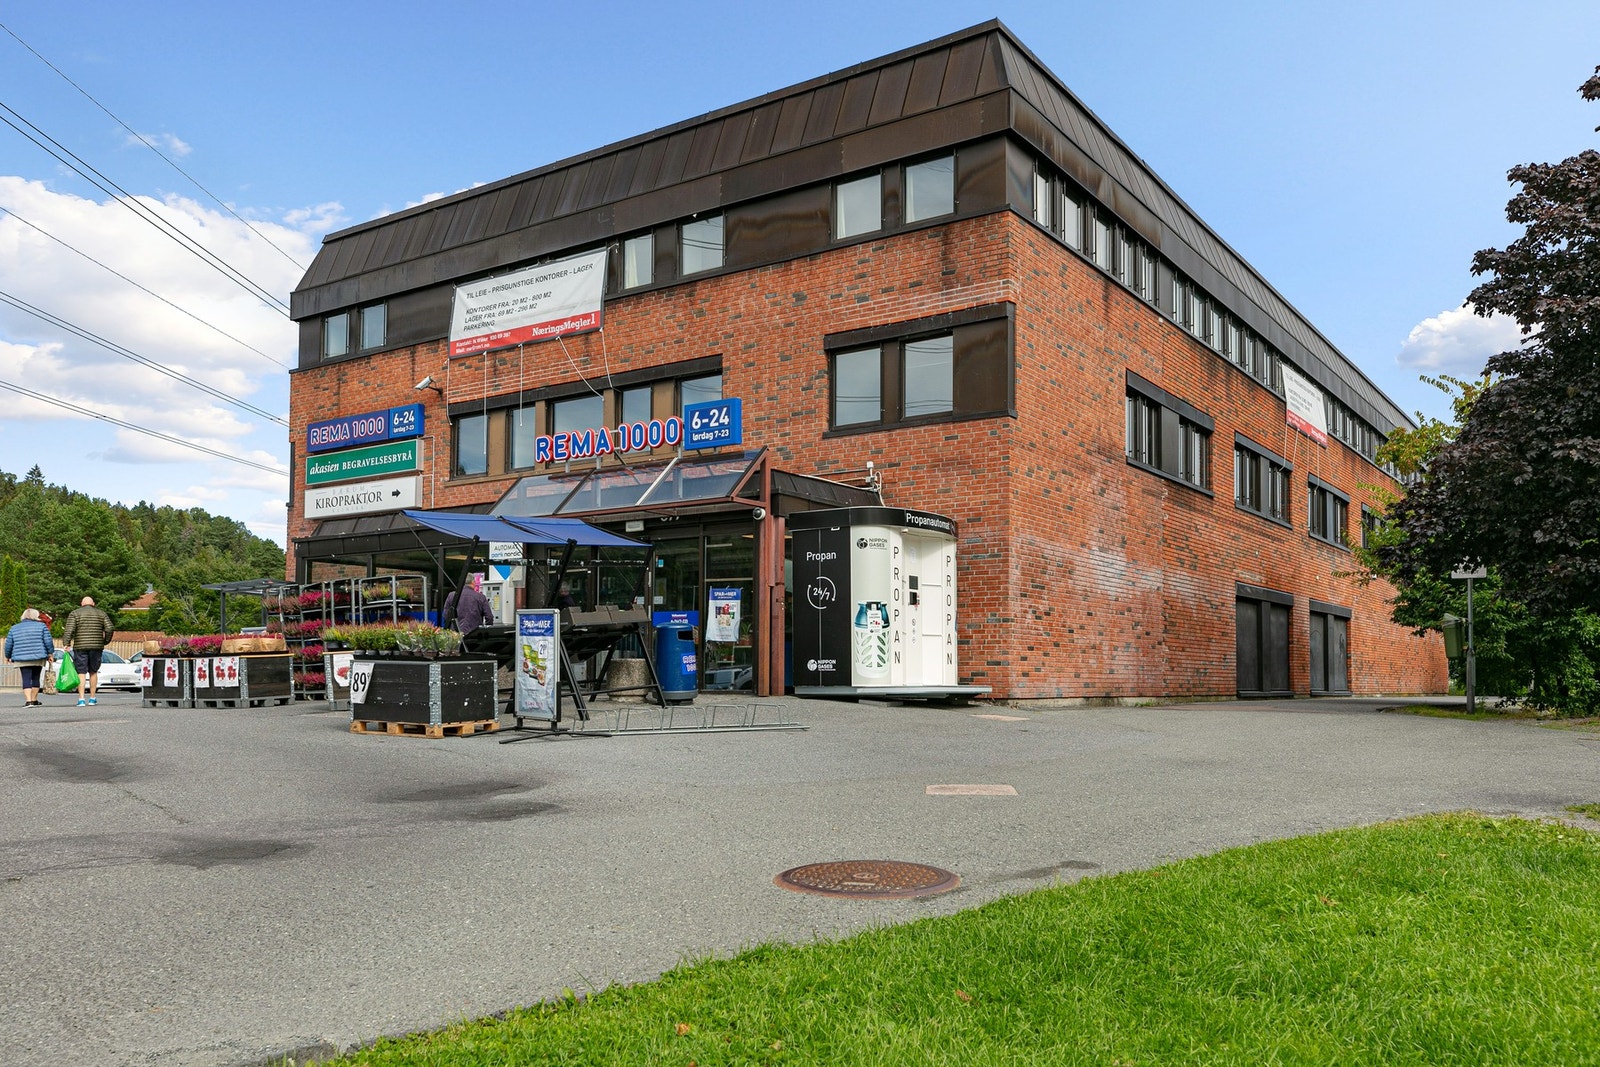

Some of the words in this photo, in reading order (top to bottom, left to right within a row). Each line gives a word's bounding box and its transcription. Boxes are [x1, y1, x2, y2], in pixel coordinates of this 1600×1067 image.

[491, 277, 535, 294] PRISGUNSTIGE
[535, 269, 568, 284] KONTORER
[573, 263, 593, 275] LAGER
[466, 303, 497, 315] KONTORER
[463, 319, 495, 332] PARKERING
[465, 313, 483, 324] LAGER
[393, 410, 415, 425] 6-24
[691, 407, 730, 430] 6-24
[310, 422, 350, 445] REMA
[352, 416, 385, 438] 1000
[535, 425, 614, 463] REMA
[618, 415, 683, 452] 1000
[692, 430, 713, 441] lørdag
[714, 428, 730, 439] 7-23
[309, 461, 340, 475] akasien
[342, 449, 413, 470] BEGRAVELSESBYRÅ
[315, 490, 383, 510] KIROPRAKTOR
[806, 551, 837, 562] Propan
[813, 587, 830, 600] 24/7
[893, 546, 901, 664] PROPAN
